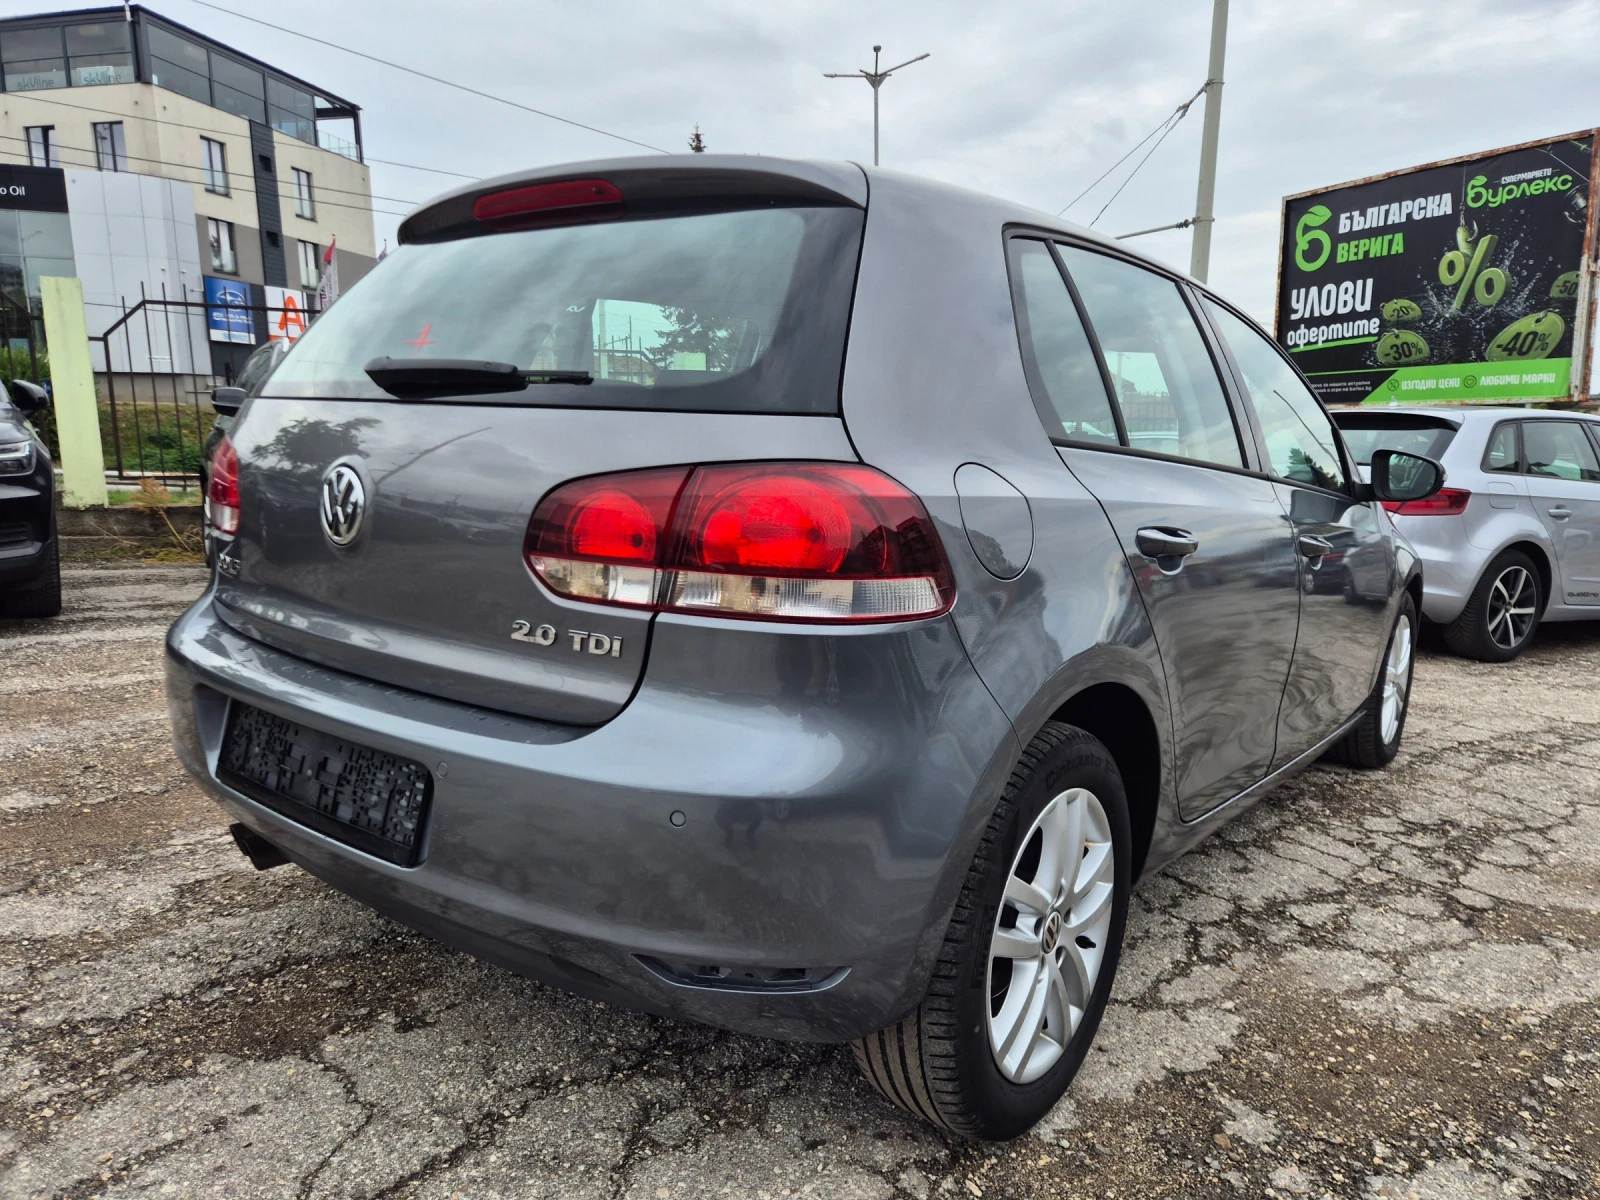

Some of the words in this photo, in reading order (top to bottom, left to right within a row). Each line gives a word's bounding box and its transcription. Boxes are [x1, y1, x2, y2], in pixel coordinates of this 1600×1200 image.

[9, 185, 26, 196] Oil
[1338, 192, 1453, 234] БЪЛГАРСКА
[1336, 232, 1404, 264] ВЕРИГА
[1290, 278, 1374, 321] УЛОВИ
[1384, 341, 1423, 361] -30%
[1496, 331, 1551, 357] -40%
[1438, 378, 1460, 389] ЦЕНИ
[1480, 374, 1519, 386] ЛЮБИМИ
[1522, 373, 1555, 384] МАРКИ
